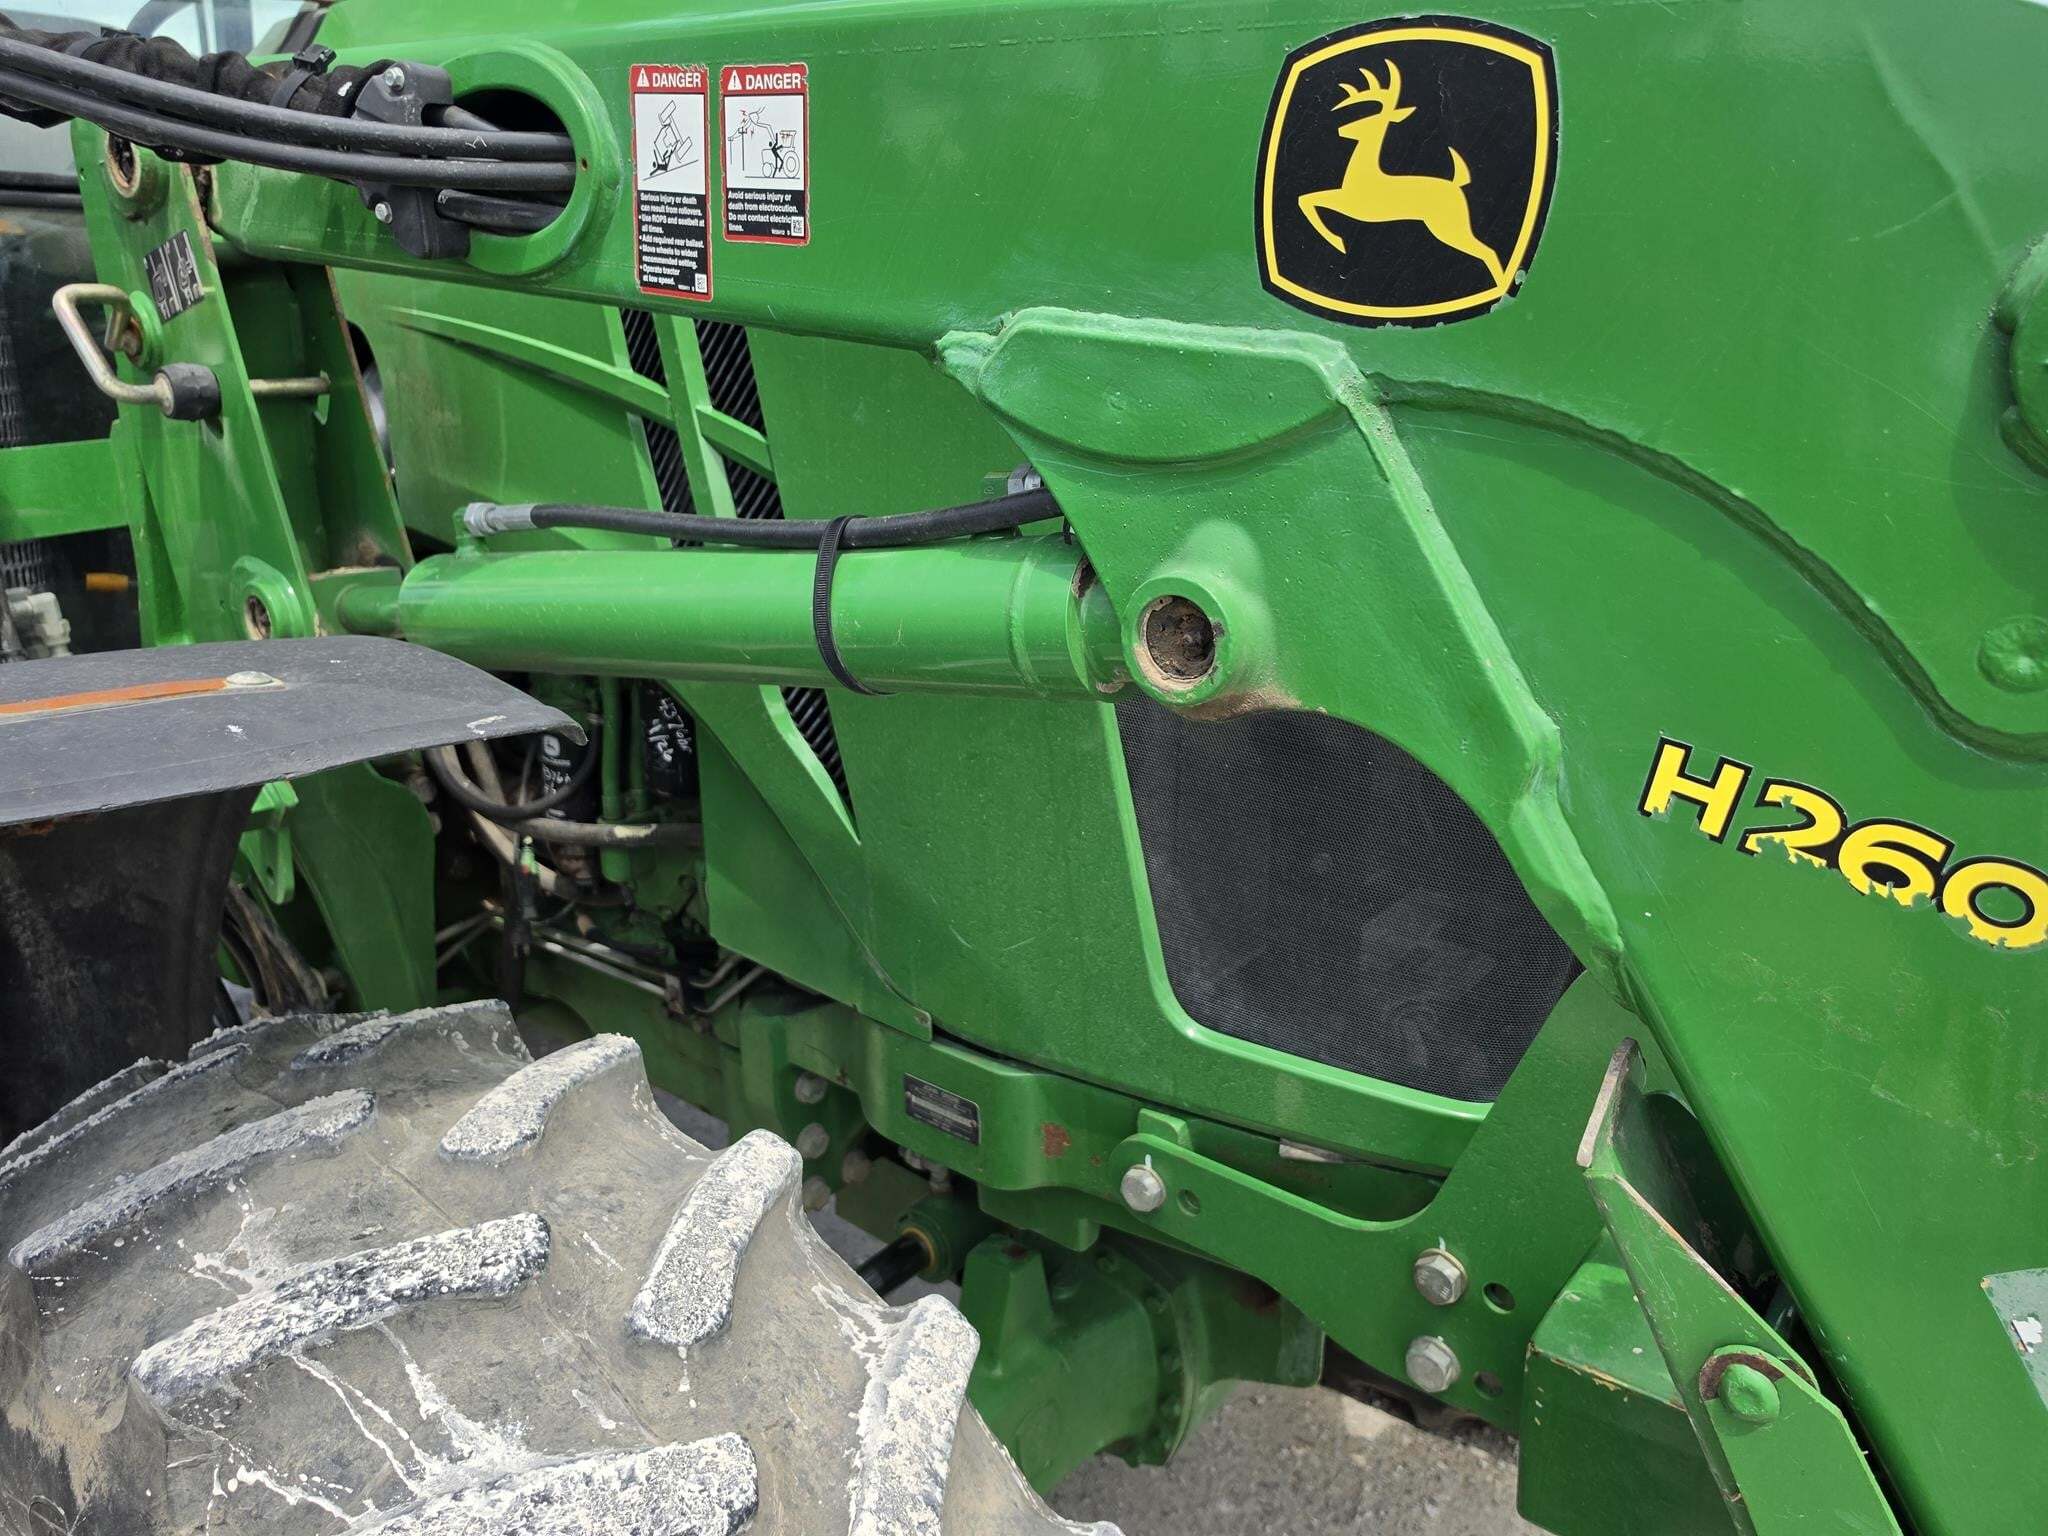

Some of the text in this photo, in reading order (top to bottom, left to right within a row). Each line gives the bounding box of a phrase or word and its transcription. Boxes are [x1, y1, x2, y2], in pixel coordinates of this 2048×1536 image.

[652, 72, 702, 88] DANGER
[745, 73, 801, 90] DANGER
[640, 192, 698, 205] Serious injury or death
[728, 190, 744, 200] Avoid
[744, 191, 766, 201] serious
[767, 192, 784, 203] injury
[651, 205, 666, 213] result
[666, 205, 678, 214] from
[728, 202, 799, 213] death from electrocution.
[642, 214, 652, 222] Use
[652, 214, 667, 224] ROPS
[667, 217, 678, 225] and
[728, 212, 792, 223] Do not contact electric
[728, 223, 744, 232] lines.
[642, 234, 653, 243] Add
[653, 235, 675, 246] required
[675, 239, 686, 247] rear
[642, 243, 656, 253] Move
[656, 246, 674, 255] wheels
[681, 249, 699, 258] widest
[642, 255, 678, 266] recommended
[642, 264, 681, 276] Operate tractor
[648, 274, 658, 283] low
[1638, 735, 2048, 950] H260
